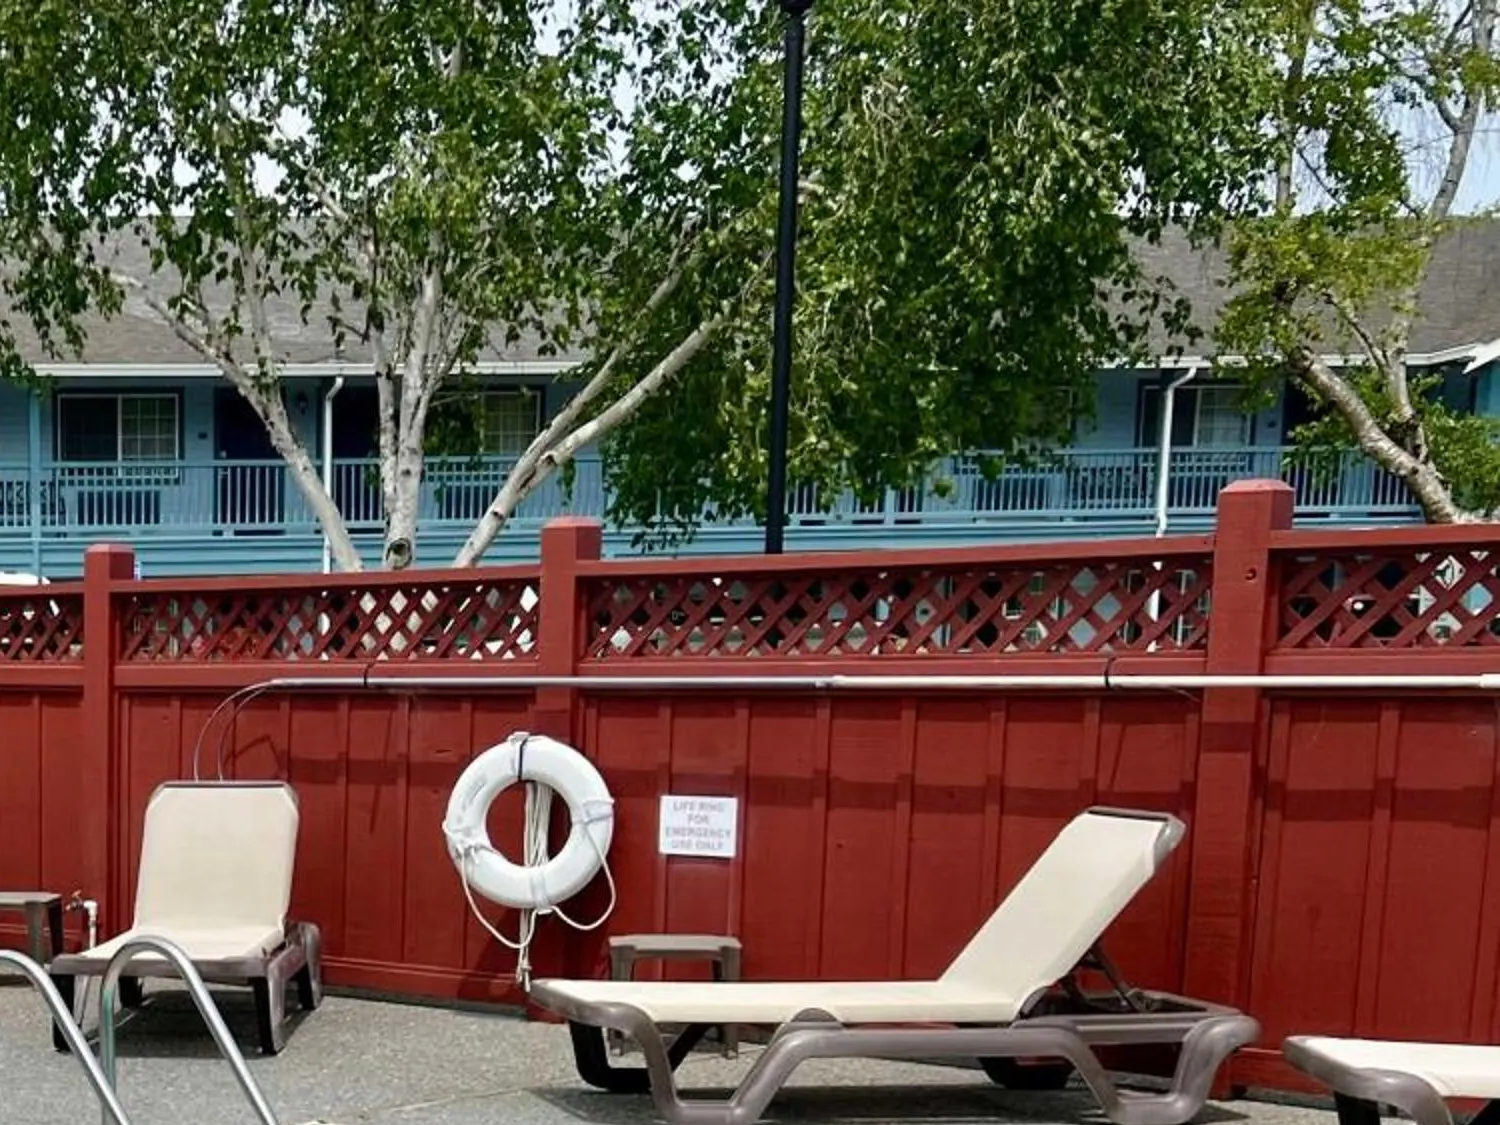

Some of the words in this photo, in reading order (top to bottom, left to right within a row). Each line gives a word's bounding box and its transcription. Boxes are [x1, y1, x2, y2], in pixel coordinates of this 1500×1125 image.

[673, 801, 695, 812] LIFE
[698, 802, 725, 812] RING
[687, 814, 710, 825] FOR
[665, 826, 731, 838] EMERGENCY
[671, 839, 693, 849] USE
[696, 840, 724, 851] ONLY
